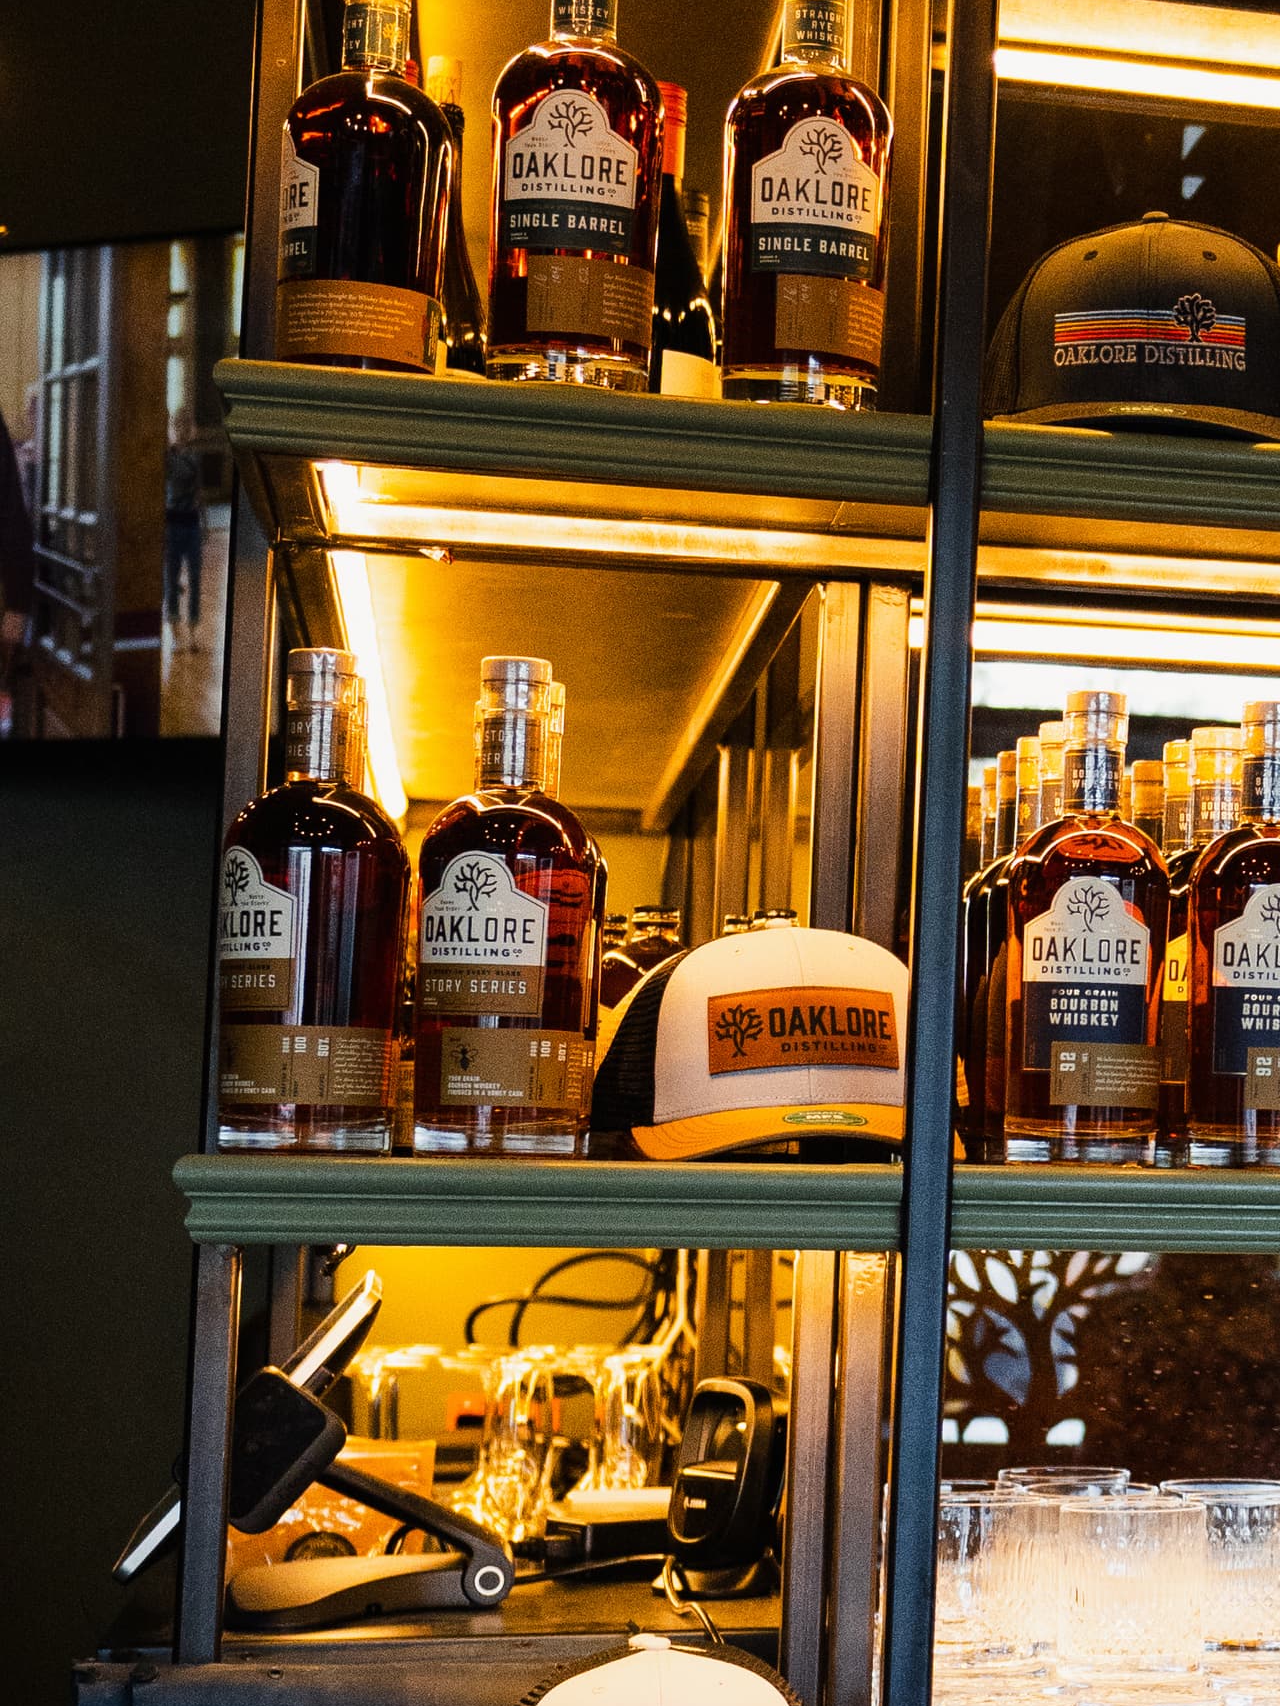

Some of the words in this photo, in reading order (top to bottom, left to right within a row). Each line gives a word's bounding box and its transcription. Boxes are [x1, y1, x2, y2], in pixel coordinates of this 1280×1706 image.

[513, 151, 628, 186] OAKLORE
[522, 183, 605, 196] DISTILLING
[760, 177, 871, 213] OAKLORE
[771, 207, 854, 223] DISTILLING
[509, 215, 563, 229] SINGLE
[567, 217, 625, 236] BARREL
[758, 237, 812, 252] SINGLE
[818, 239, 870, 261] BARREL
[1054, 345, 1136, 367] OAKLORE
[1145, 346, 1246, 372] DISTILLING
[425, 917, 536, 944] OAKLORE
[431, 946, 509, 957] DISTILLING
[1033, 936, 1140, 965] OAKLORE
[1041, 965, 1122, 976] DISTILLING
[231, 973, 276, 989] SERIES
[425, 979, 464, 993] STORY
[470, 979, 527, 994] SERIES
[1084, 989, 1119, 997] GRAIN
[1050, 998, 1119, 1012] BOURBON
[769, 1005, 891, 1040] OAKLORE
[1049, 1013, 1119, 1027] WHISKEY
[540, 1040, 550, 1057] 100
[781, 1042, 877, 1053] DISTILLING
